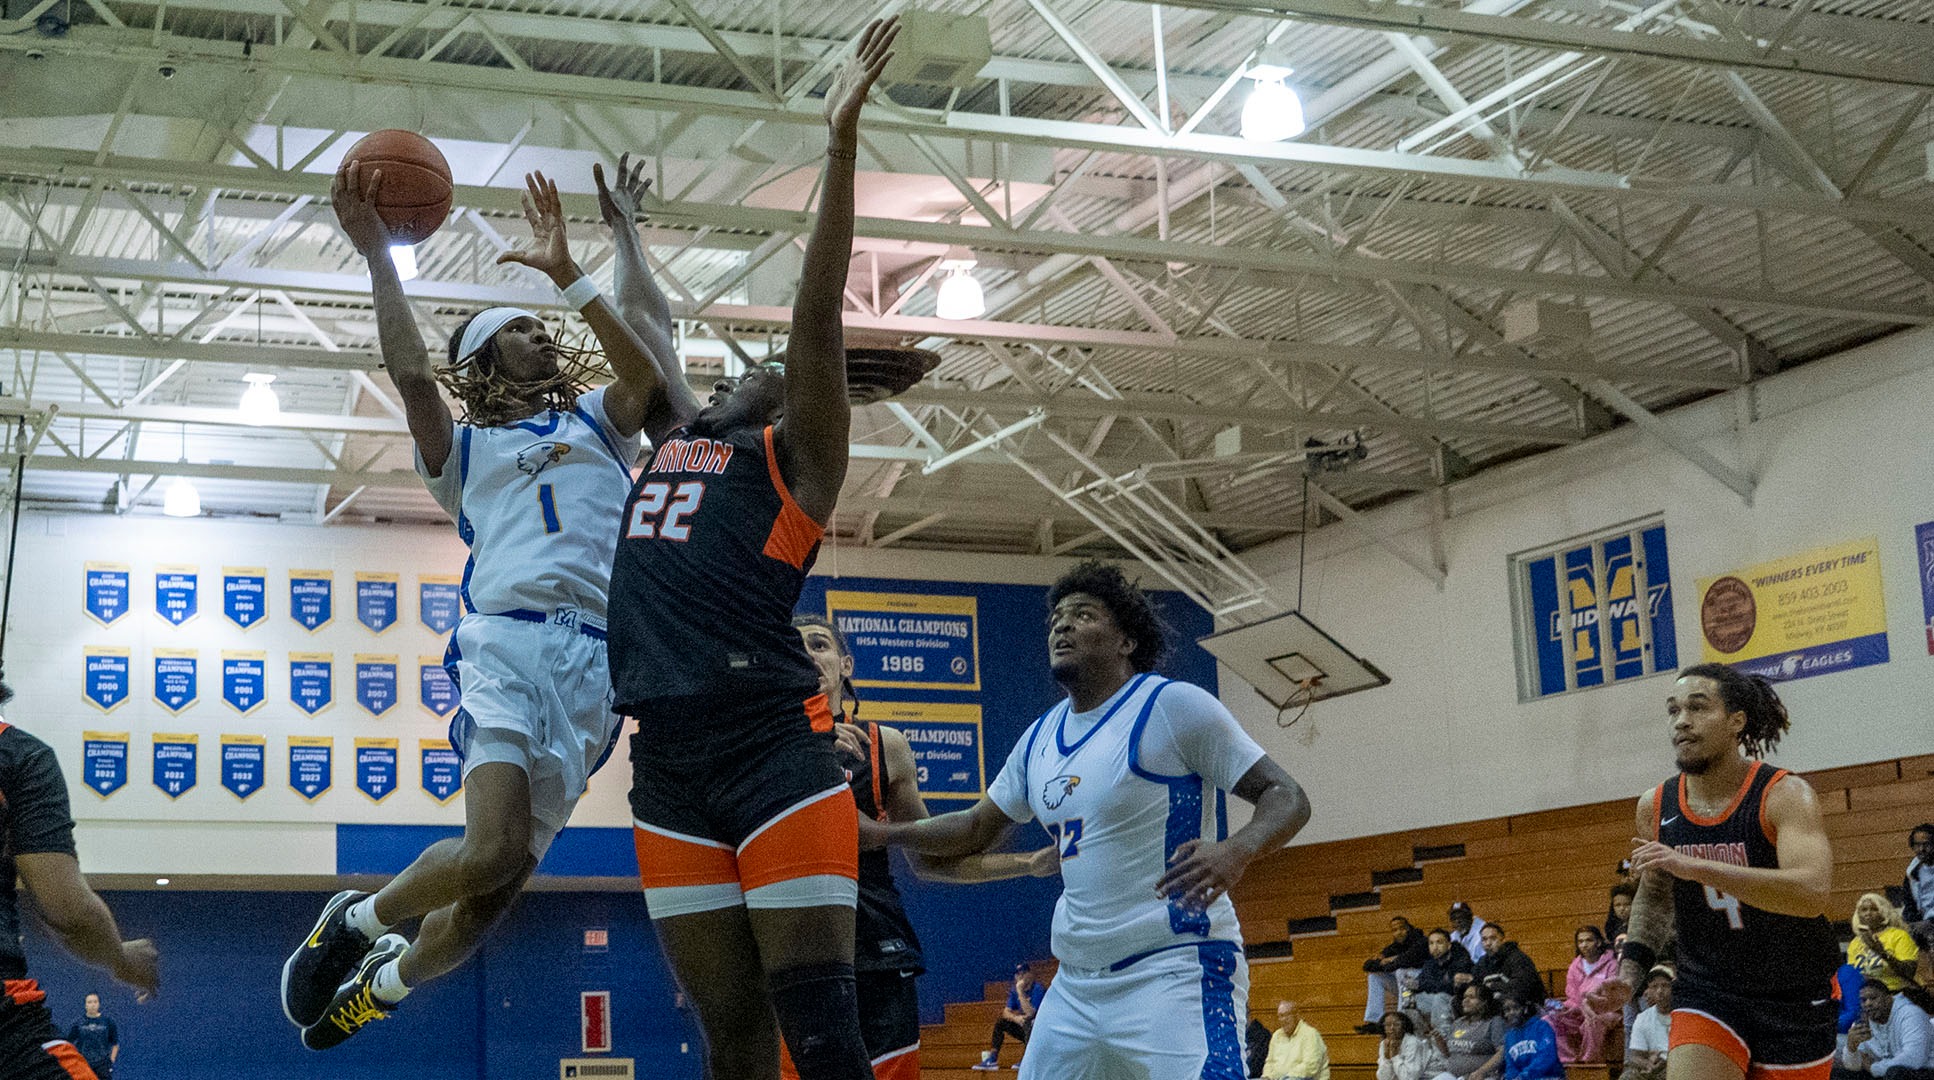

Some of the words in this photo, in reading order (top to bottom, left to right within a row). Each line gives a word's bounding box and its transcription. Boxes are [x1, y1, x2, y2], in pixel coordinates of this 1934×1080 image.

[649, 438, 734, 475] UNION
[537, 483, 563, 536] 1
[625, 480, 706, 543] 22
[1805, 558, 1841, 578] EVERY
[90, 578, 126, 588] CHAMPIONS
[158, 581, 195, 590] CHAMPIONS
[226, 583, 262, 592] CHAMPIONS
[293, 586, 328, 595] CHAMPIONS
[359, 588, 394, 598] CHAMPIONS
[423, 590, 457, 600] CHAMPIONS
[554, 607, 577, 628] M
[837, 617, 896, 633] NATIONAL
[898, 619, 968, 639] CHAMPIONS
[856, 637, 877, 647] IHSA
[879, 637, 914, 648] Western
[915, 638, 949, 649] Division
[881, 655, 924, 673] 1986
[1802, 650, 1853, 670] EAGLES
[89, 662, 126, 672] CHAMPIONS
[158, 665, 194, 675] CHAMPIONS
[225, 666, 261, 676] CHAMPIONS
[293, 669, 328, 678] CHAMPIONS
[359, 671, 394, 680] CHAMPIONS
[902, 728, 972, 746] CHAMPIONS
[87, 749, 124, 758] CHAMPIONS
[157, 751, 193, 760] CHAMPIONS
[225, 752, 261, 761] CHAMPIONS
[292, 754, 328, 762] CHAMPIONS
[926, 749, 962, 760] Division
[359, 755, 394, 764] CHAMPIONS
[424, 756, 459, 764] CHAMPIONS
[1675, 842, 1749, 868] UNION
[1703, 885, 1744, 929] 4
